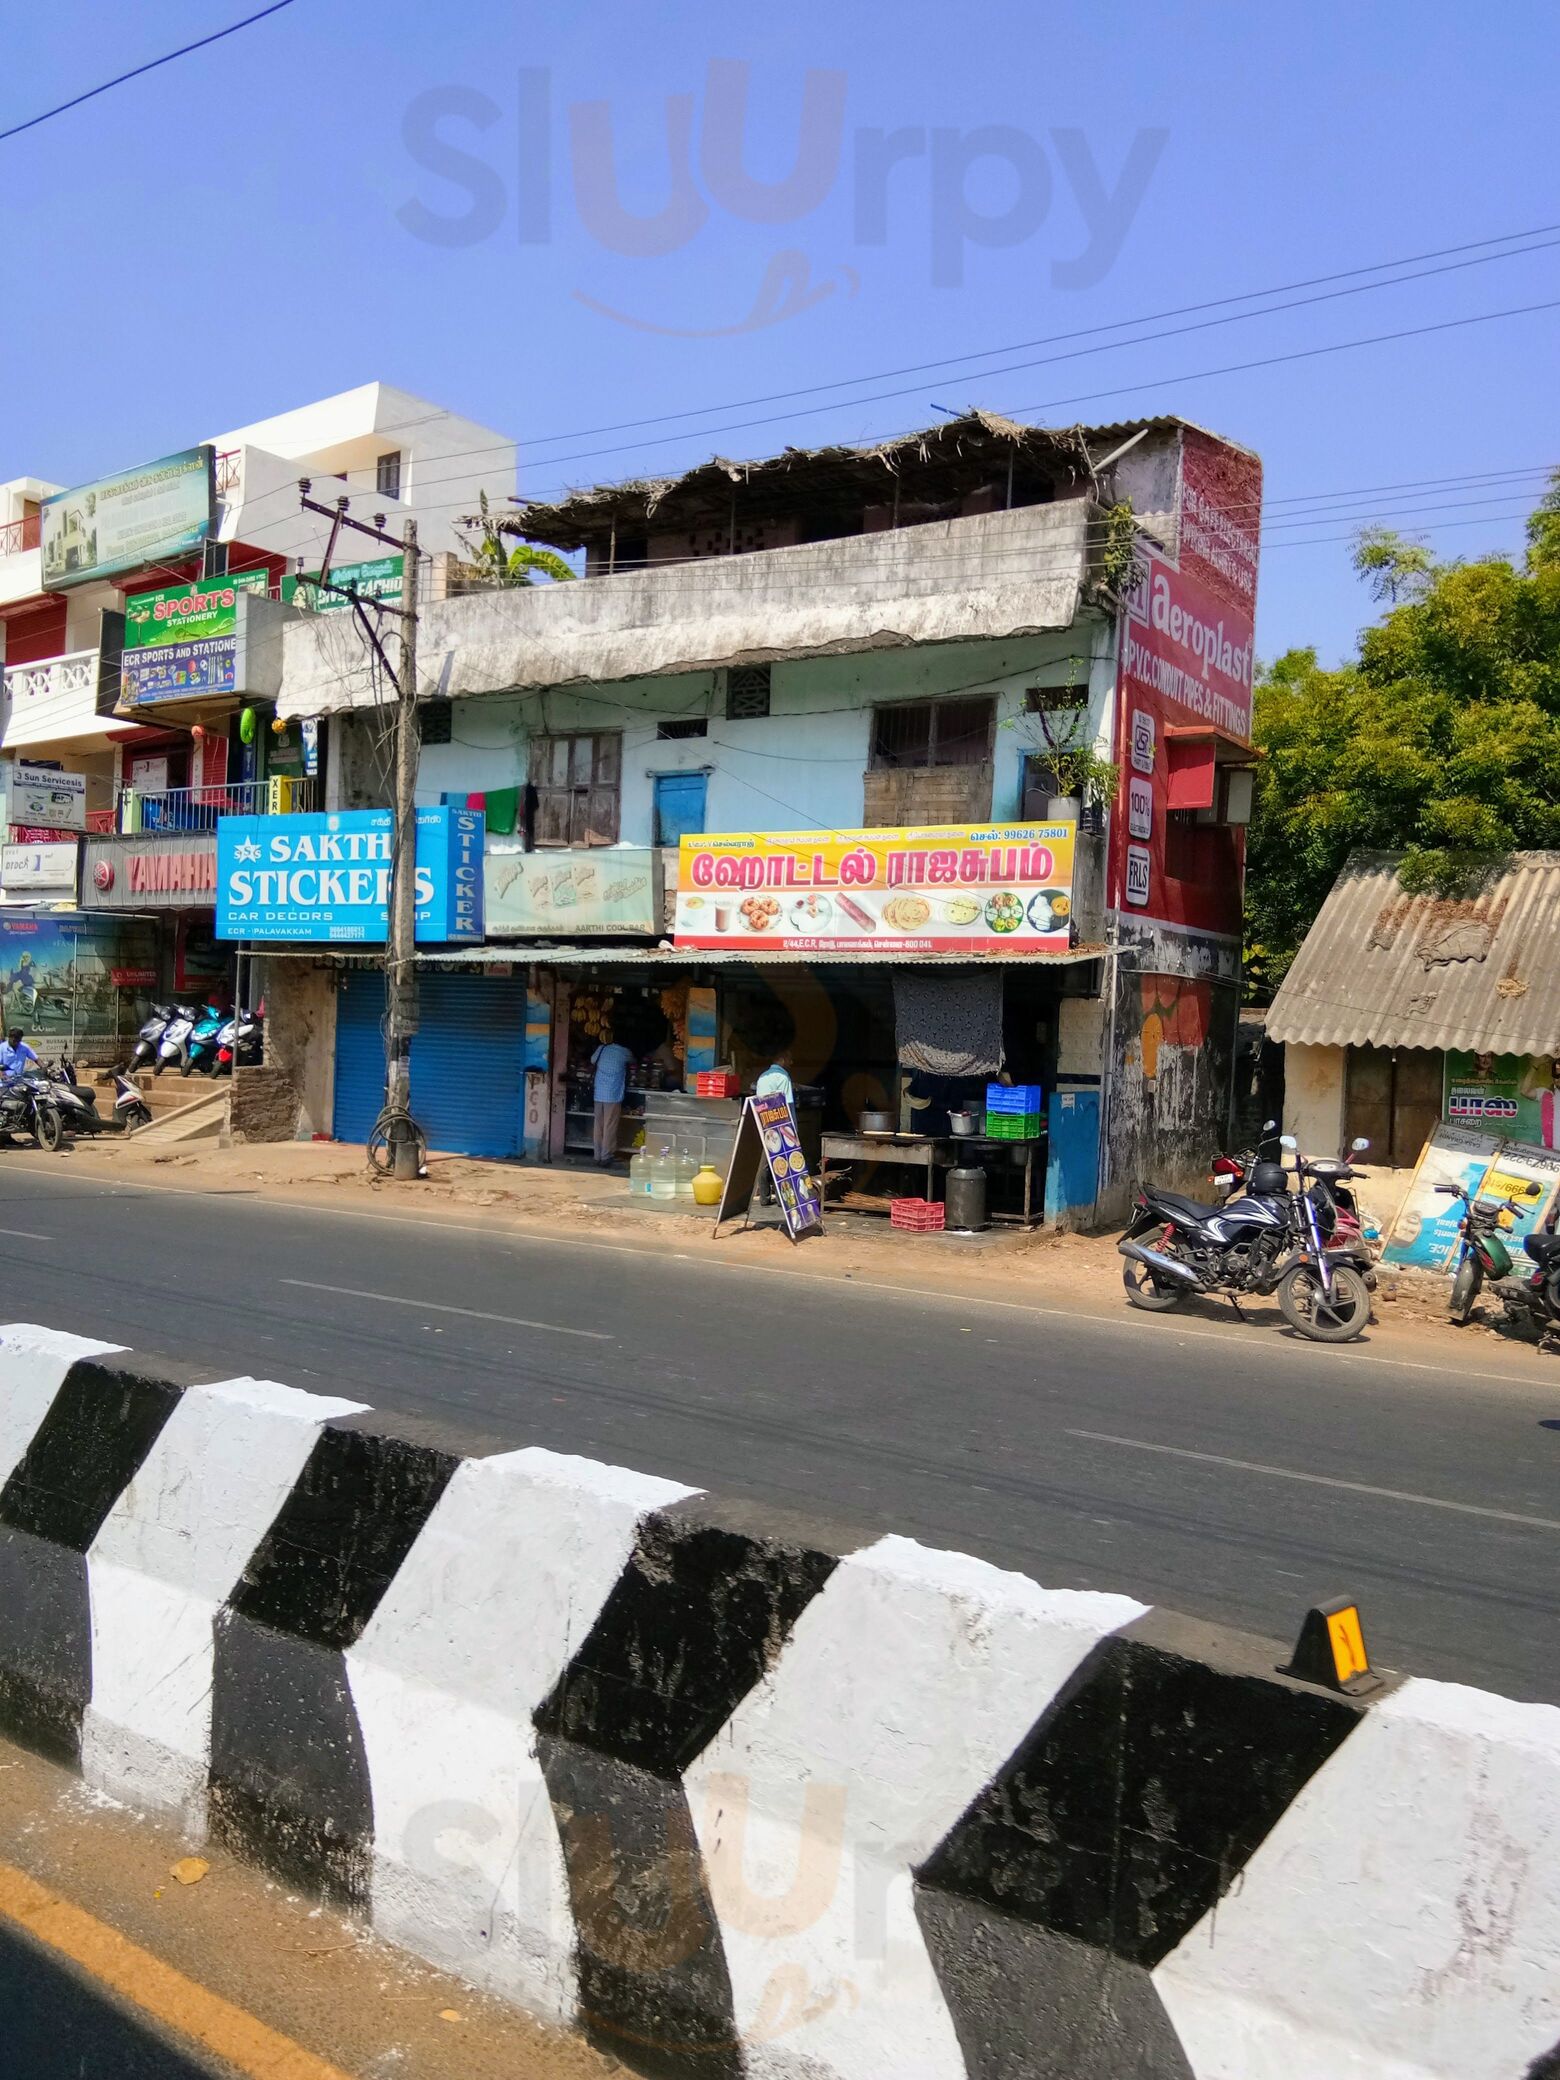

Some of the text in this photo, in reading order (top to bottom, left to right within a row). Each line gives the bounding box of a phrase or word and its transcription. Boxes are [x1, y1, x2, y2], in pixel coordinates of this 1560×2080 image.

[153, 588, 235, 621] SPORTS
[166, 611, 218, 627] STATIONERY
[1152, 574, 1250, 687] aeroplast
[123, 655, 140, 667] ECR
[142, 647, 174, 664] SPORTS
[176, 647, 192, 659] AND
[1203, 688, 1213, 719] &
[24, 773, 40, 781] Sun
[1130, 790, 1151, 818] 100%
[1004, 829, 1036, 840] 99626
[1038, 828, 1068, 838] 75801
[269, 832, 393, 863] SAKTH
[692, 847, 877, 892] ஹோட்டல்
[1128, 860, 1148, 889] FRLS
[228, 911, 431, 922] CAR DECORS SP
[575, 924, 604, 932] AARTHI
[227, 927, 246, 935] ECR
[253, 927, 312, 936] PALAVAKKAM
